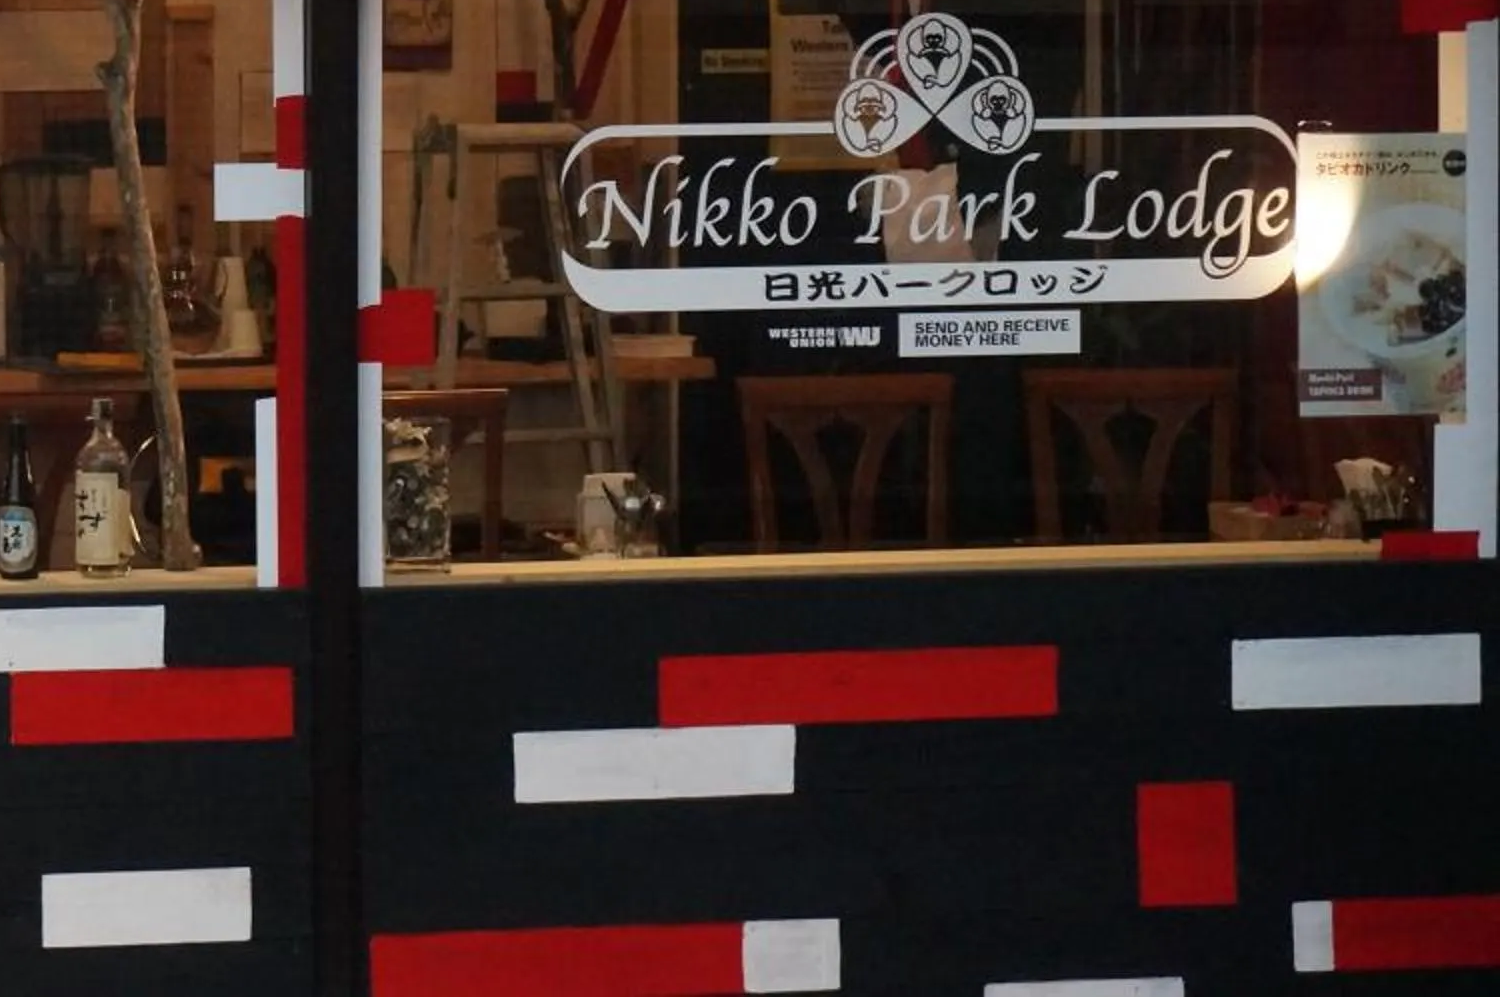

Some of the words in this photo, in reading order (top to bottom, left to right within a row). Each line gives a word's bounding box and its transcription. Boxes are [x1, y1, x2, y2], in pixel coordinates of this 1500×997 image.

[577, 155, 817, 250] Nikko
[847, 153, 1042, 245] Park
[1063, 149, 1291, 280] Lodge
[763, 264, 1109, 302] 日光パークロッジ
[768, 328, 835, 340] WESTERN
[914, 321, 960, 335] SEND
[963, 320, 999, 334] AND
[1003, 318, 1071, 333] RECEIVE
[789, 338, 835, 348] UNION
[914, 333, 975, 348] MONEY
[979, 332, 1021, 346] HERE
